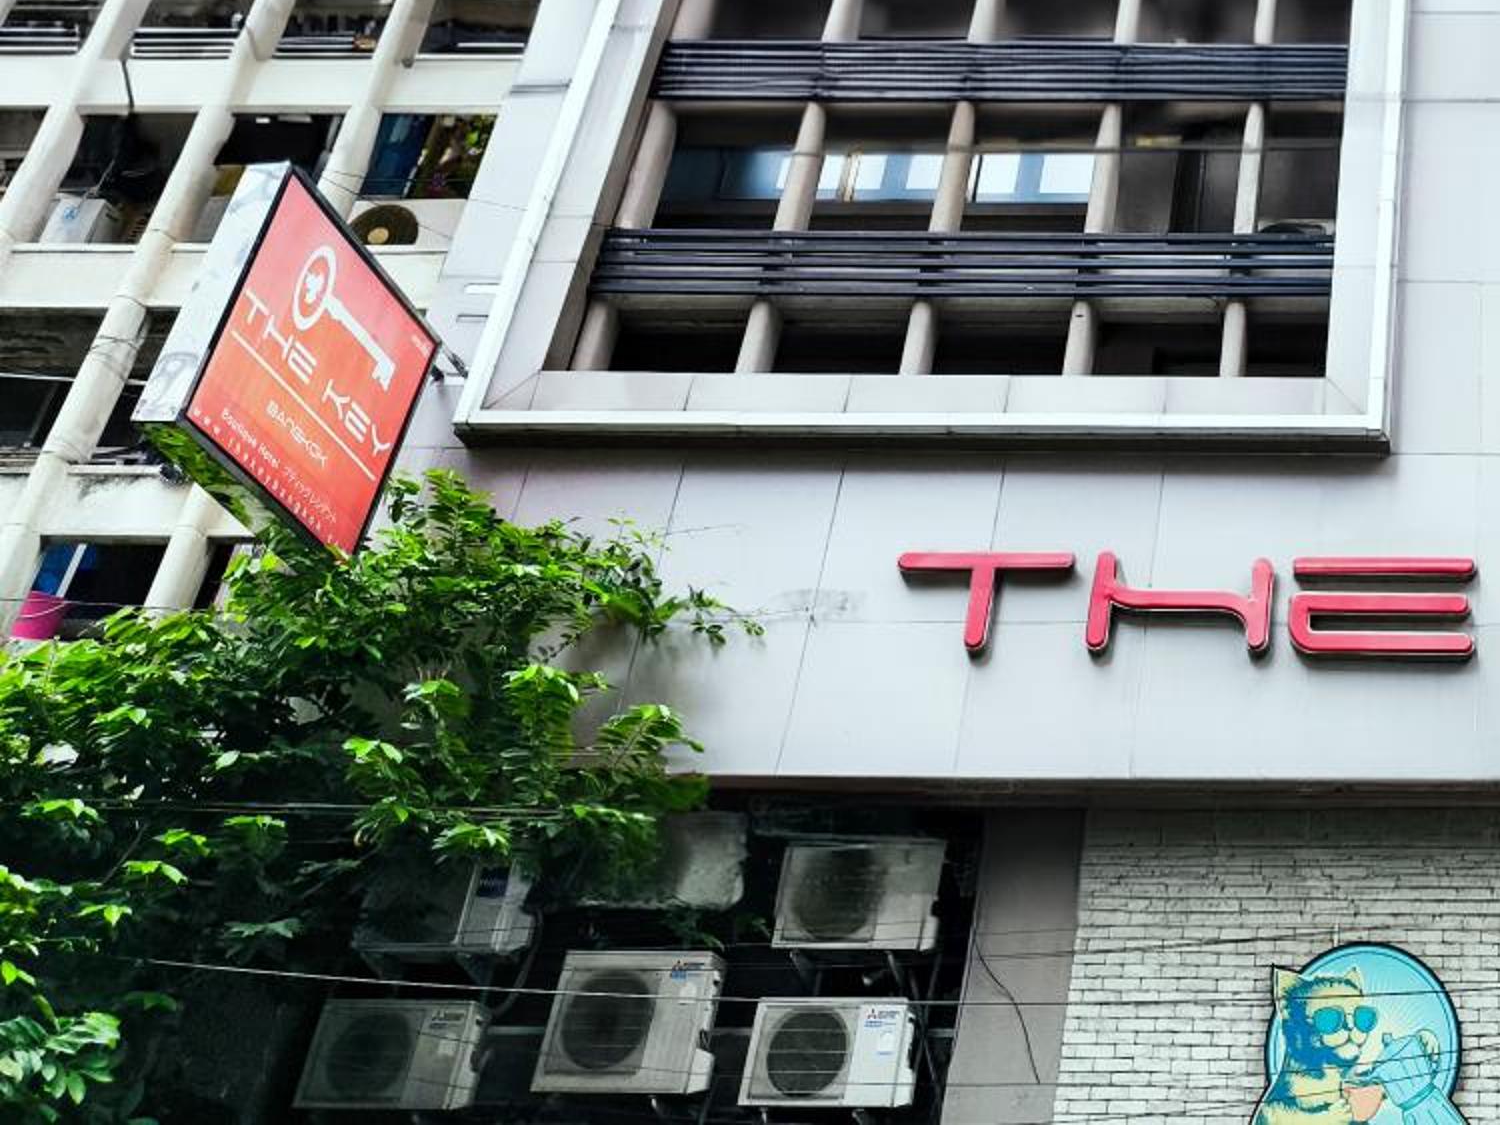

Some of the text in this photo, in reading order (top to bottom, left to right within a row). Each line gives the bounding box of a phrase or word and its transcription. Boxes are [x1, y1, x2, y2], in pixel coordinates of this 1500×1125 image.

[245, 289, 318, 385] THE
[321, 378, 392, 458] KEY
[897, 552, 1478, 656] THE
